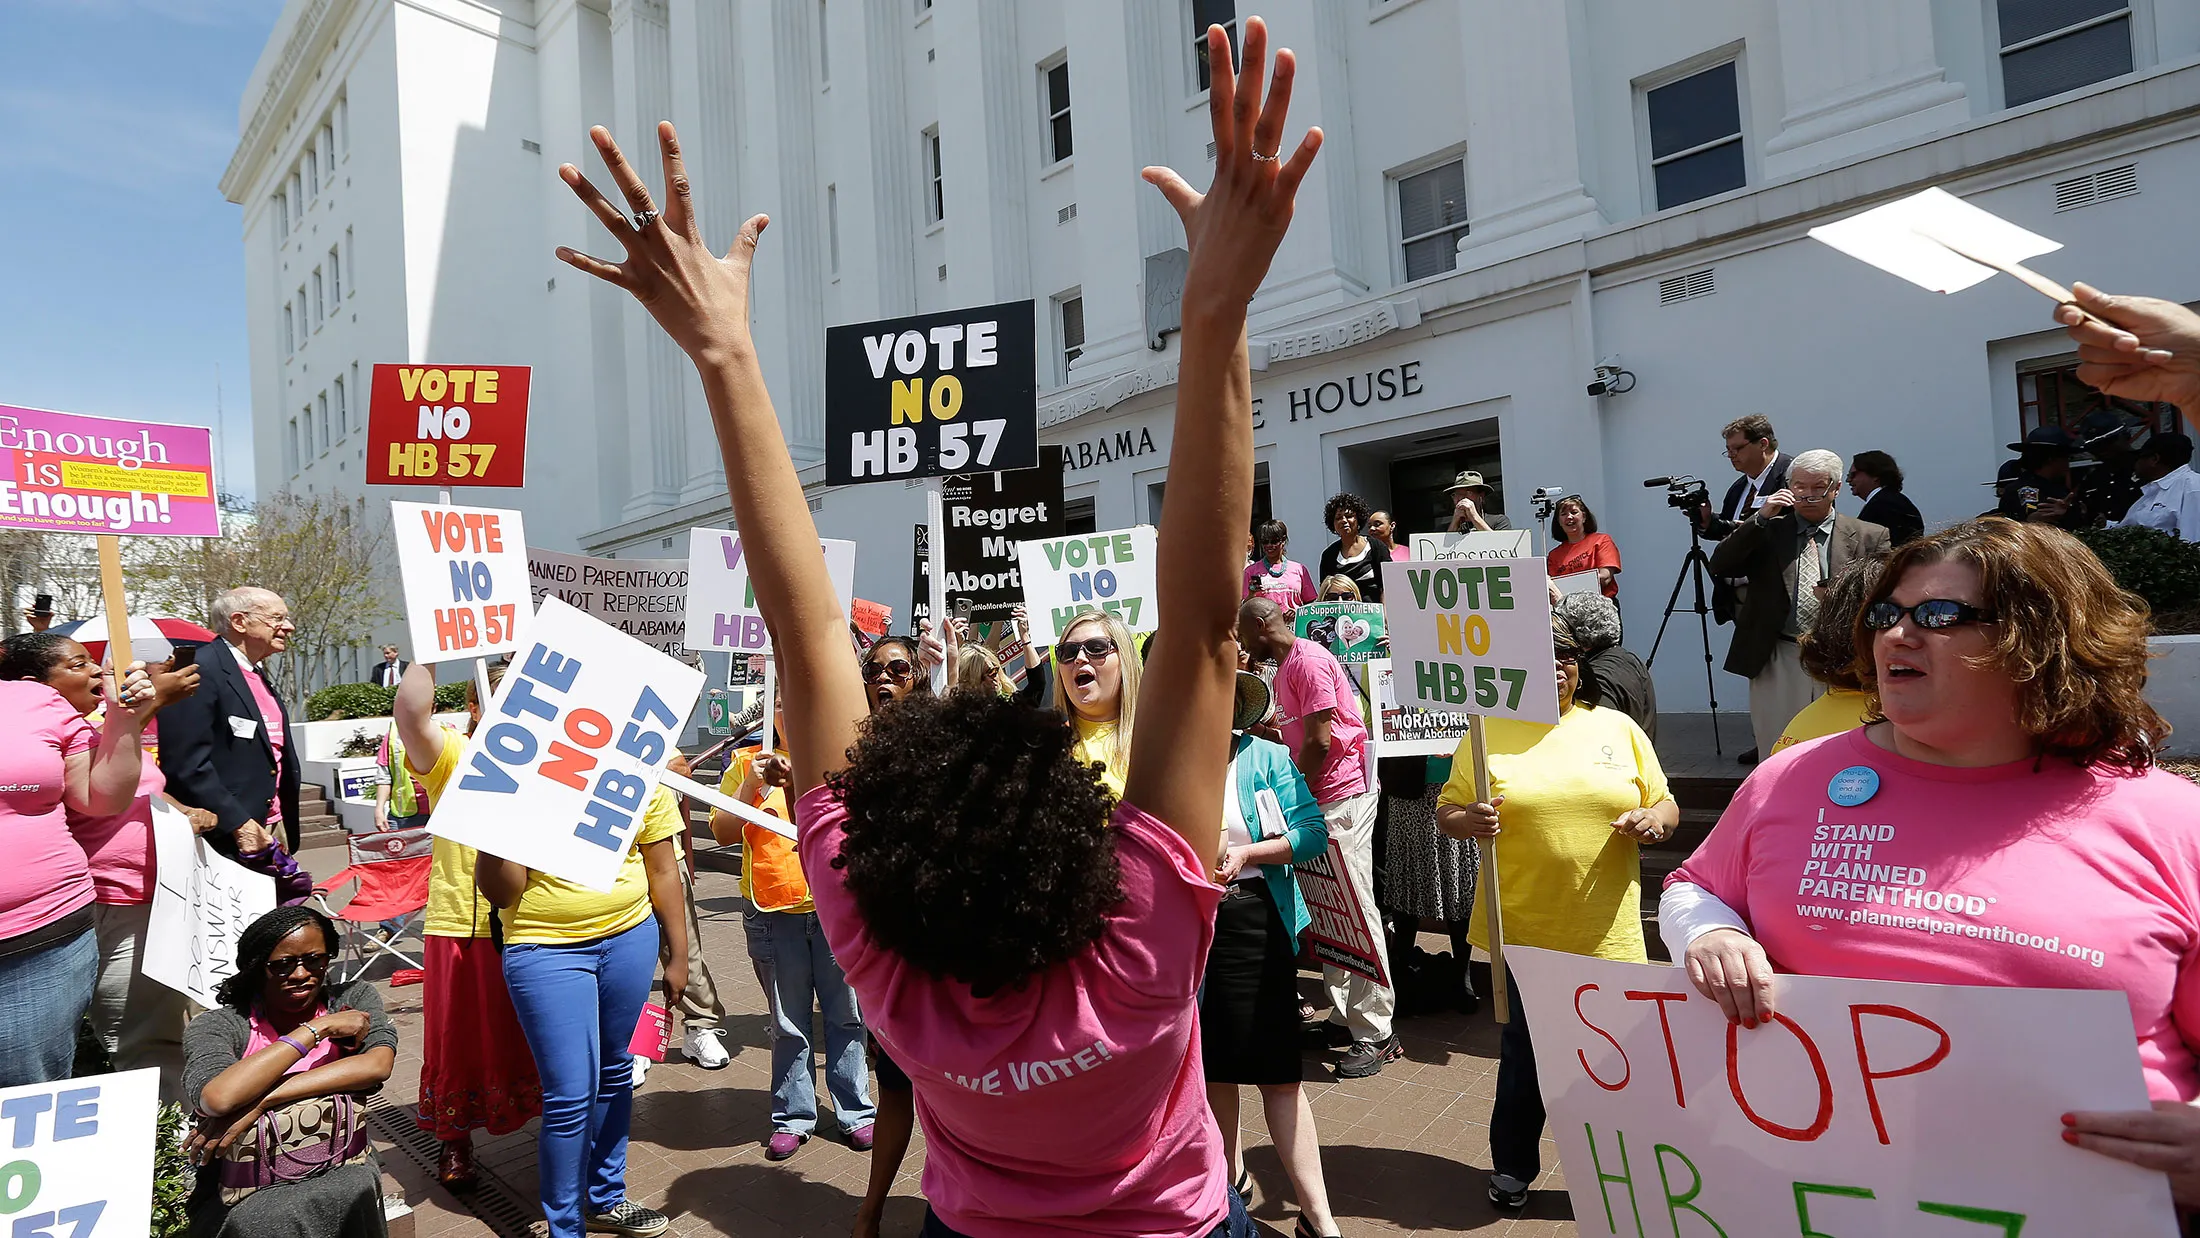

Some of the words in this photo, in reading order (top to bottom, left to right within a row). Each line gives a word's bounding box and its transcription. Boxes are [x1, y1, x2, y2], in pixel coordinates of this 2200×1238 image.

[862, 320, 998, 379] VOTE
[1270, 310, 1390, 360] DEFENDERE
[398, 368, 499, 403] VOTE
[891, 374, 963, 425] NO
[1287, 361, 1424, 422] HOUSE
[417, 405, 471, 440] NO
[0, 416, 171, 471] Enough
[388, 442, 439, 477] HB
[447, 443, 497, 478] 57
[851, 426, 919, 477] HB
[939, 418, 1007, 470] 57
[22, 451, 61, 487] is
[69, 464, 104, 474] Women's
[104, 467, 142, 477] healthcare
[142, 471, 175, 480] decisions
[175, 473, 199, 481] should
[69, 471, 80, 479] be
[81, 472, 93, 480] left
[140, 476, 151, 484] her
[152, 478, 174, 488] family
[175, 479, 190, 487] and
[92, 480, 109, 488] with
[109, 481, 122, 489] the
[122, 483, 150, 491] counsel
[159, 485, 172, 493] her
[0, 480, 173, 530] Enough!
[952, 502, 1048, 530] Regret
[421, 510, 503, 553] VOTE
[982, 536, 1020, 562] My
[1042, 533, 1135, 571] VOTE
[449, 560, 492, 602] NO
[528, 559, 577, 583] ANNED
[583, 565, 688, 588] PARENTHOOD
[944, 567, 1023, 593] Abort
[1069, 569, 1118, 602] NO
[1407, 565, 1515, 610] VOTE
[603, 591, 686, 613] REPRESEN
[1298, 607, 1309, 617] We
[1310, 605, 1342, 617] Support
[1343, 603, 1381, 614] WOMEN'S
[434, 607, 479, 651] HB
[483, 603, 515, 644] 57
[619, 619, 686, 636] ALABAMA
[1435, 613, 1491, 656] NO
[1350, 651, 1385, 662] SAFETY
[1415, 661, 1467, 706] HB
[1473, 665, 1528, 712] 57
[458, 642, 582, 794] VOTE
[1383, 732, 1397, 742] on
[1399, 729, 1423, 740] New
[537, 707, 613, 791] NO
[573, 768, 646, 852] HB
[616, 685, 678, 766] 57
[1813, 824, 1895, 842] STAND
[1817, 807, 1825, 823] I
[1810, 843, 1873, 861] WITH
[192, 862, 202, 921] NO
[1802, 860, 1928, 887] PLANNED
[205, 864, 232, 993] ANSWER
[1796, 903, 2105, 968] www.plannedparenthood.org
[188, 935, 204, 996] DO
[944, 1068, 1003, 1096] WE
[1008, 1040, 1113, 1092] VOTE!
[1573, 983, 1951, 1146] STOP
